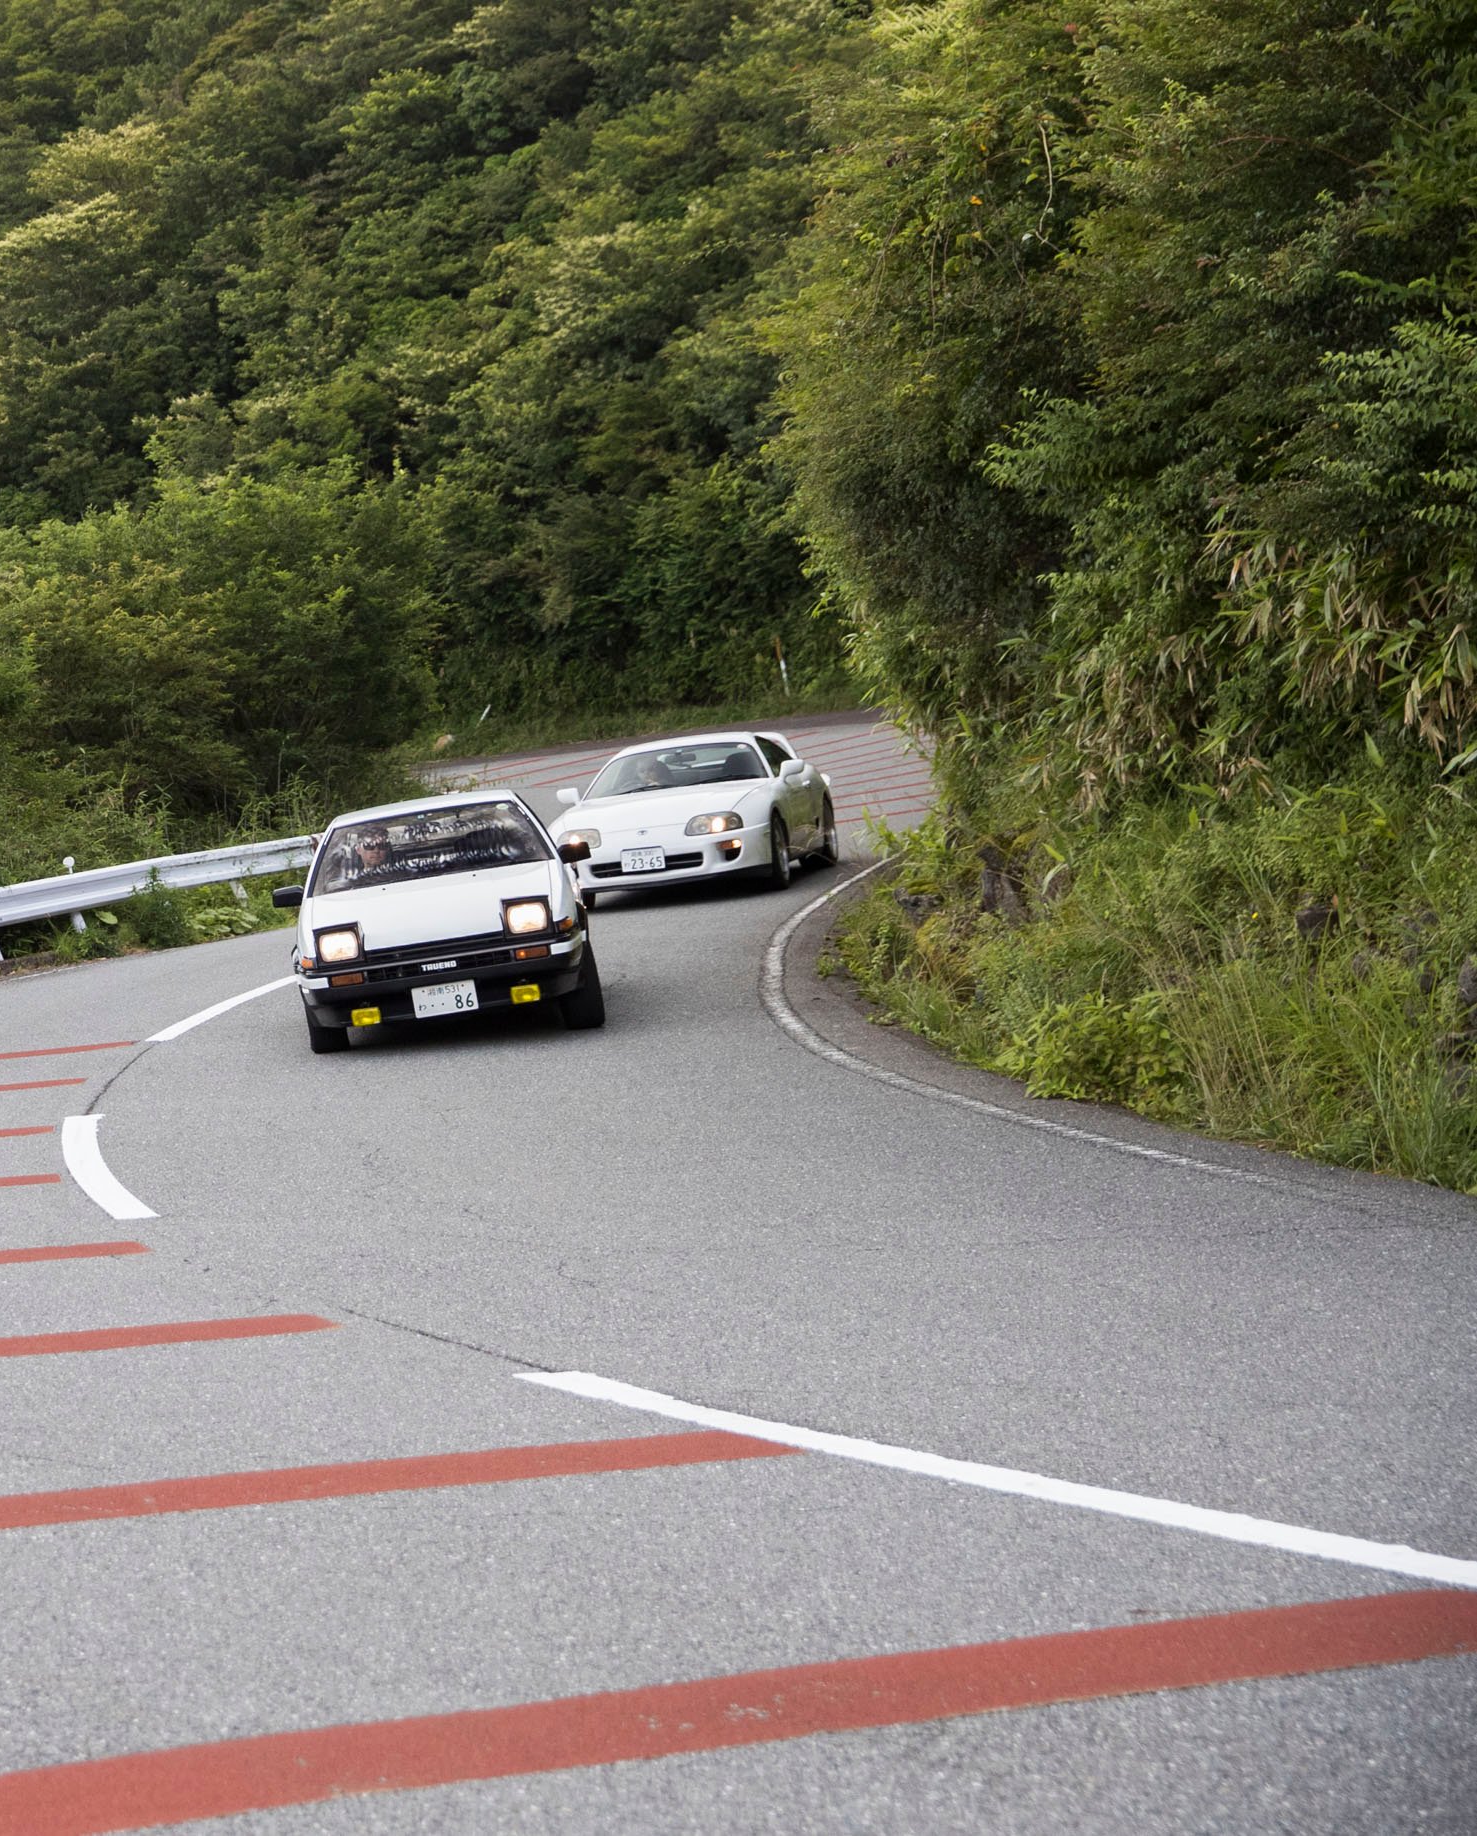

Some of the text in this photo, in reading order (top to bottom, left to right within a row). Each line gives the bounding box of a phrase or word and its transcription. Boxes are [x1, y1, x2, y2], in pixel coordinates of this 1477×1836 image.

[630, 856, 663, 869] 23-65
[421, 960, 457, 971] TRUENO
[455, 993, 474, 1009] 86
